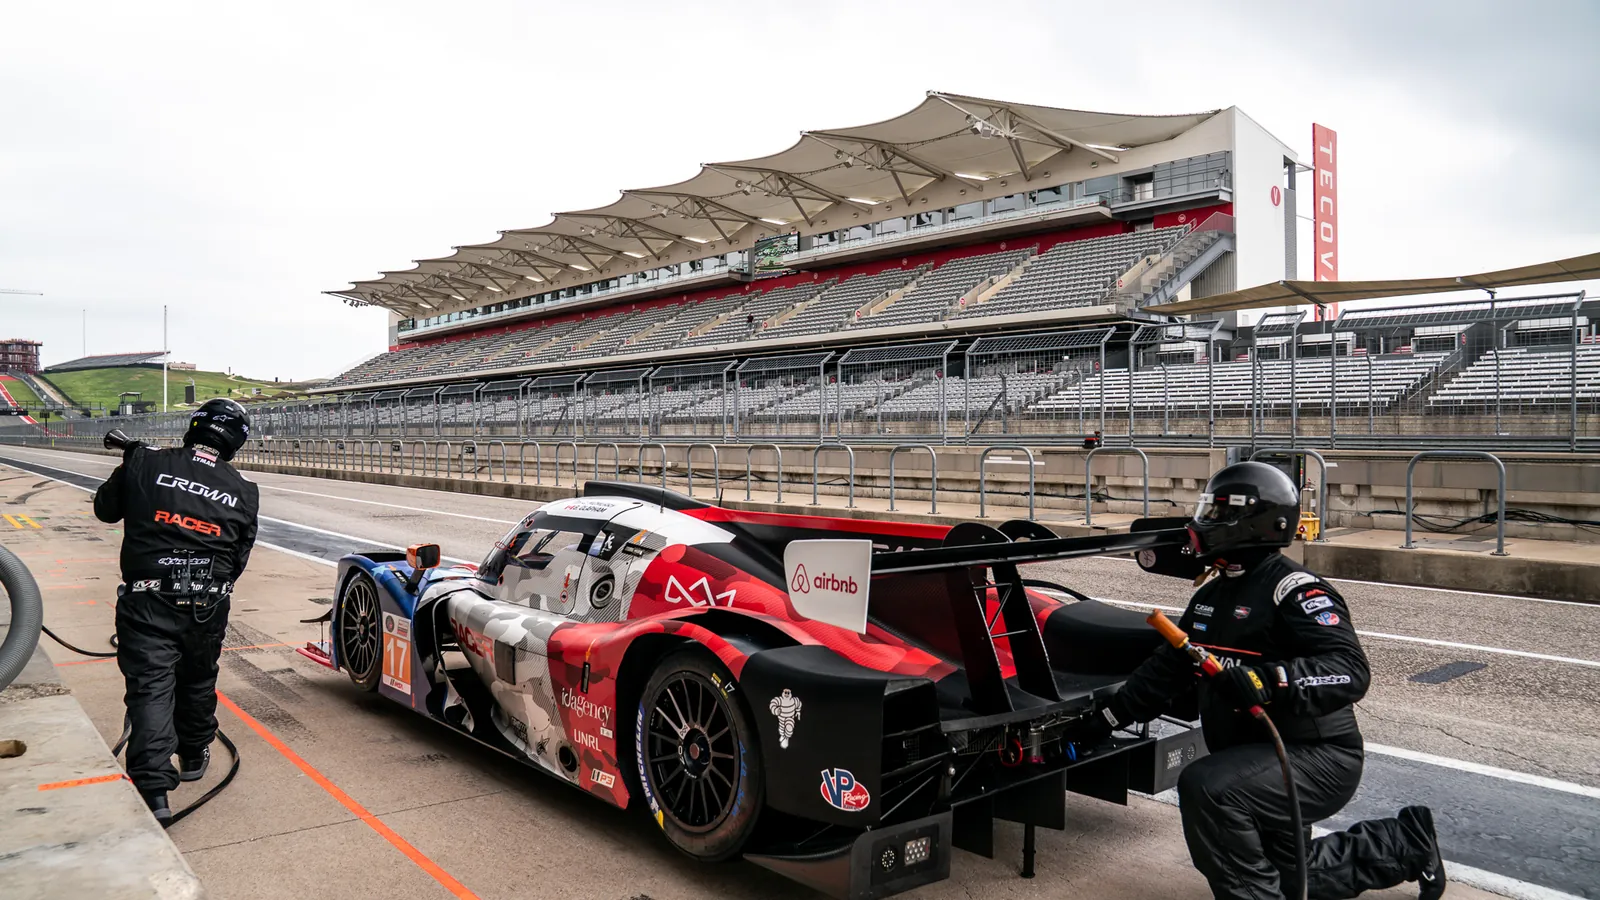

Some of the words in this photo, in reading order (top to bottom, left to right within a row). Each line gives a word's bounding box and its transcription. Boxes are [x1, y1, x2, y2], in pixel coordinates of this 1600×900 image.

[209, 423, 225, 433] MATT
[192, 456, 216, 468] LYMAN
[156, 473, 238, 508] CROWN
[154, 511, 221, 537] RACER
[813, 572, 858, 595] airbnb
[386, 637, 408, 679] 17
[561, 686, 611, 728] idagency
[573, 728, 602, 753] UNRL
[635, 709, 652, 798] MICHELIN
[599, 774, 614, 786] P3
[821, 767, 855, 809] VP
[843, 793, 869, 805] Racing
